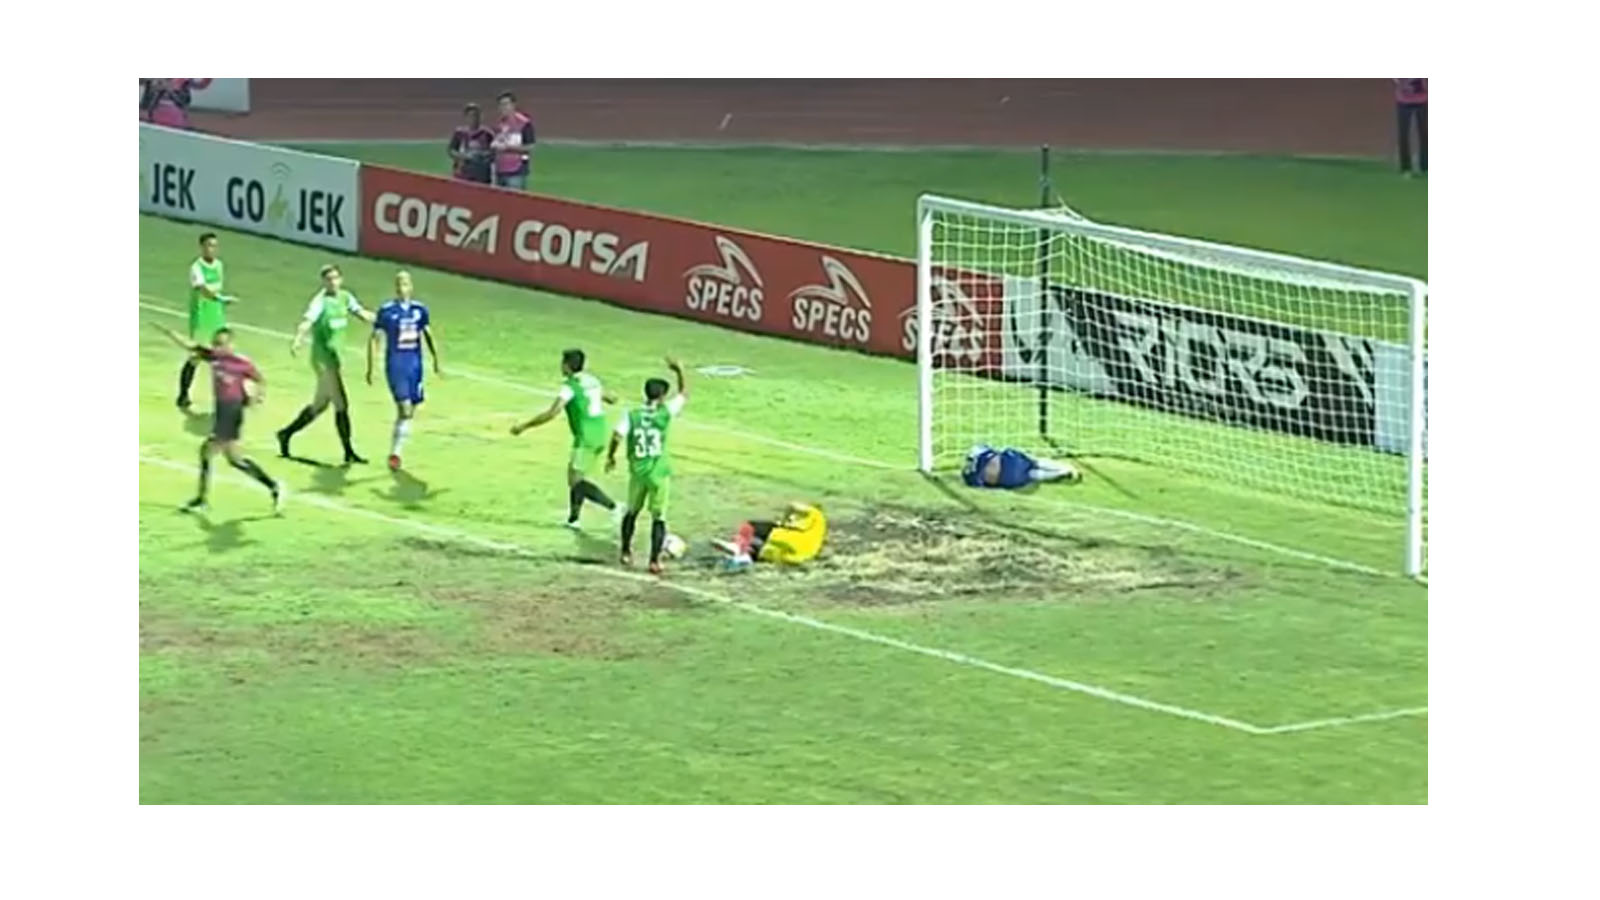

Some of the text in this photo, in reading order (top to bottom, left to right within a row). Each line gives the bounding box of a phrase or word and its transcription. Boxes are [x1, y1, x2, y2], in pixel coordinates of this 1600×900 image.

[151, 163, 196, 211] JEK
[226, 176, 345, 238] GO JEK
[686, 276, 764, 322] SPECS
[792, 296, 872, 343] SPECS
[902, 317, 984, 362] SECS
[633, 428, 662, 458] 33
